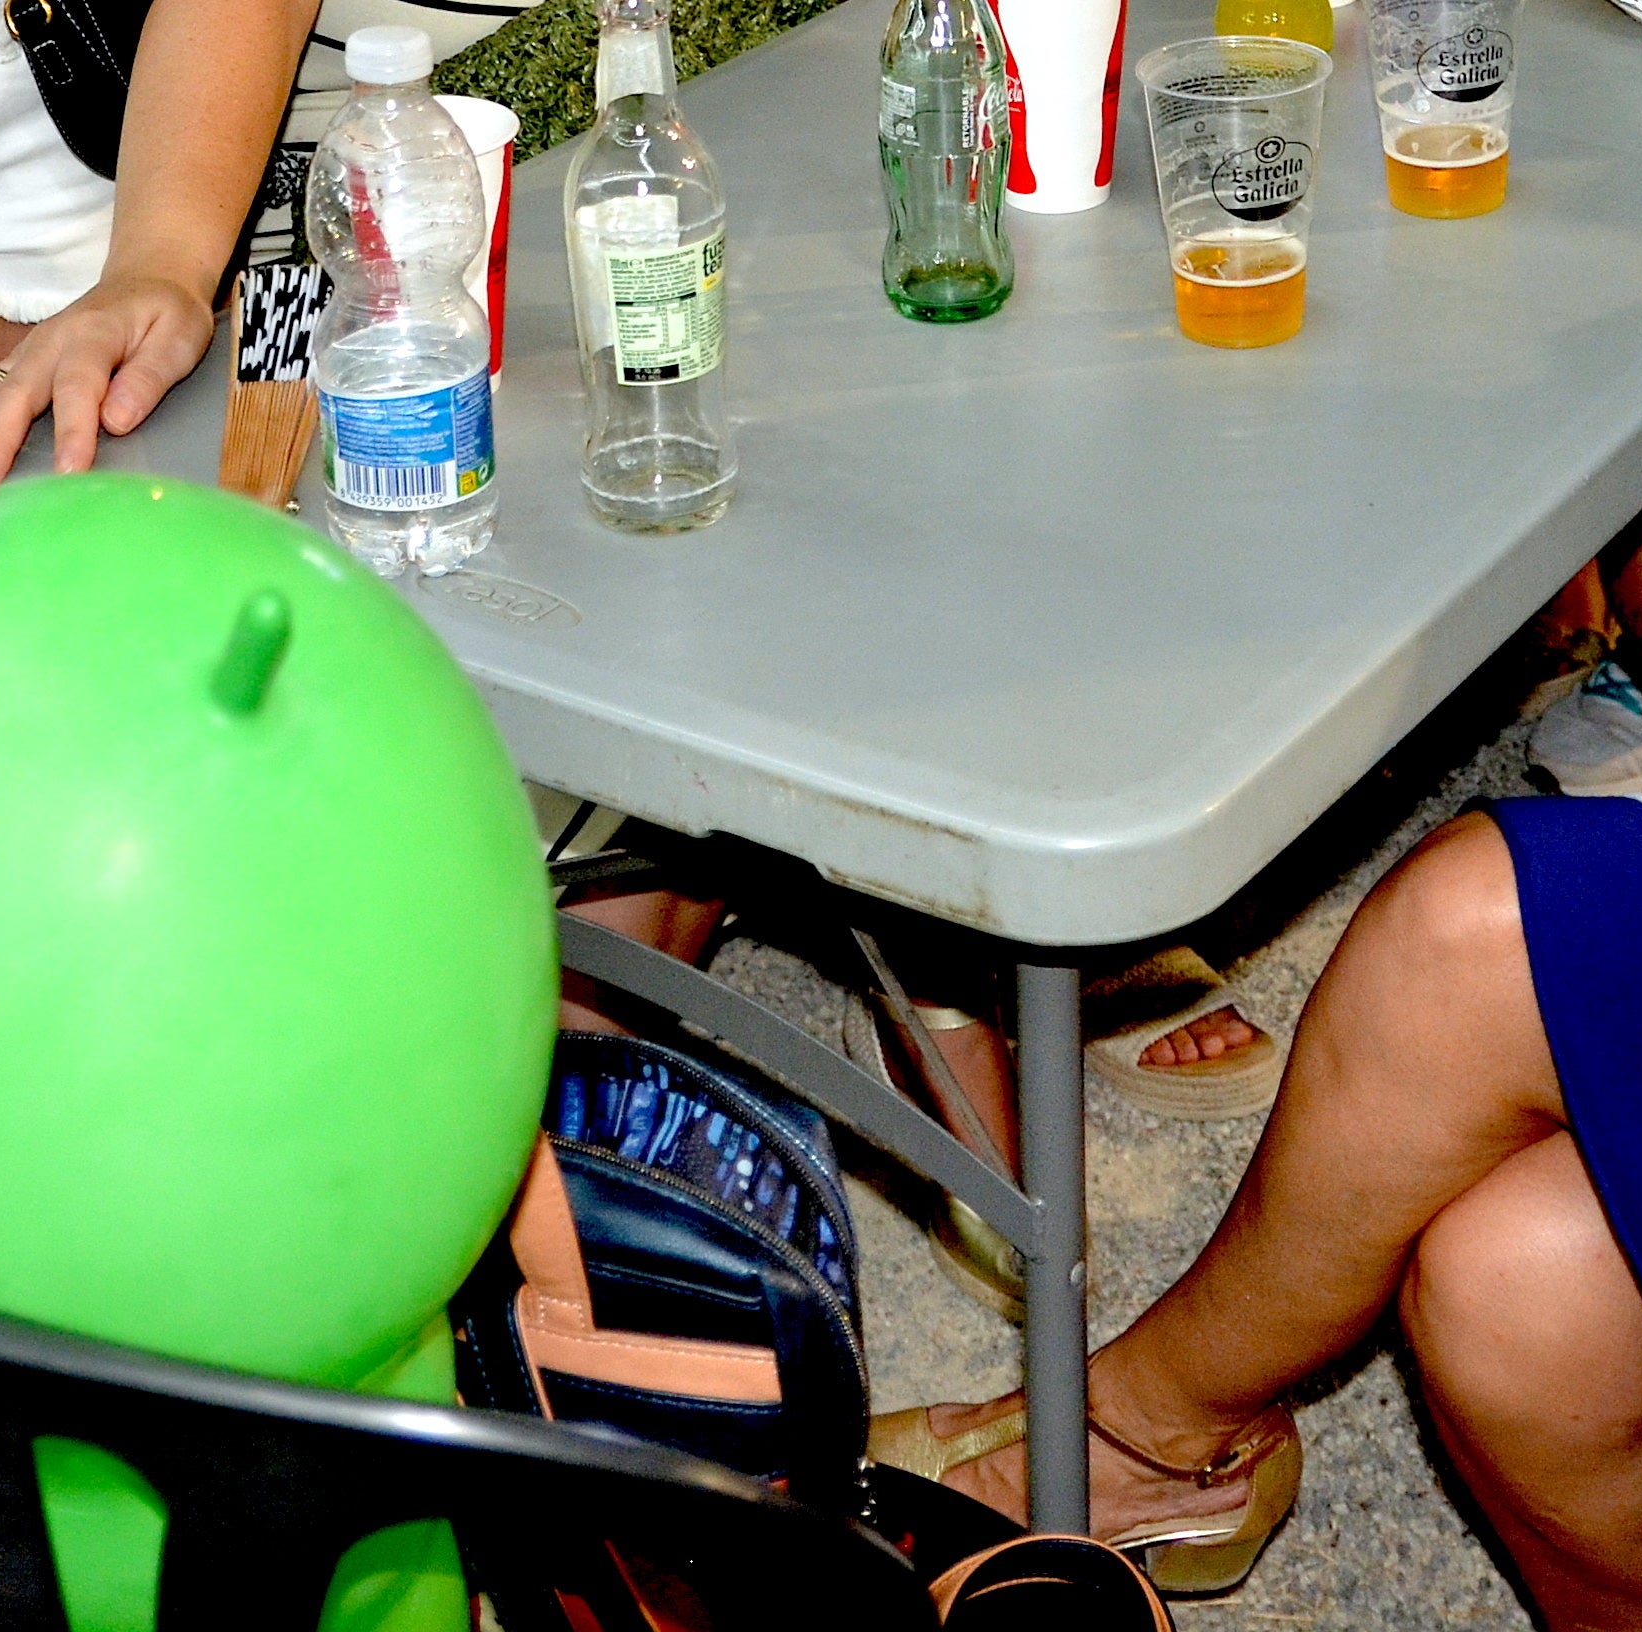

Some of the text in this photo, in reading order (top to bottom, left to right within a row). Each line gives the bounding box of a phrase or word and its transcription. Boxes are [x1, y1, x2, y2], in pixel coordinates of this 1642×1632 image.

[1438, 45, 1504, 67] Estrella
[1439, 63, 1500, 85] Galicia
[1231, 157, 1304, 184] Estrella
[1234, 179, 1299, 203] Galicia
[350, 492, 391, 508] 429359
[397, 494, 444, 508] 001452
